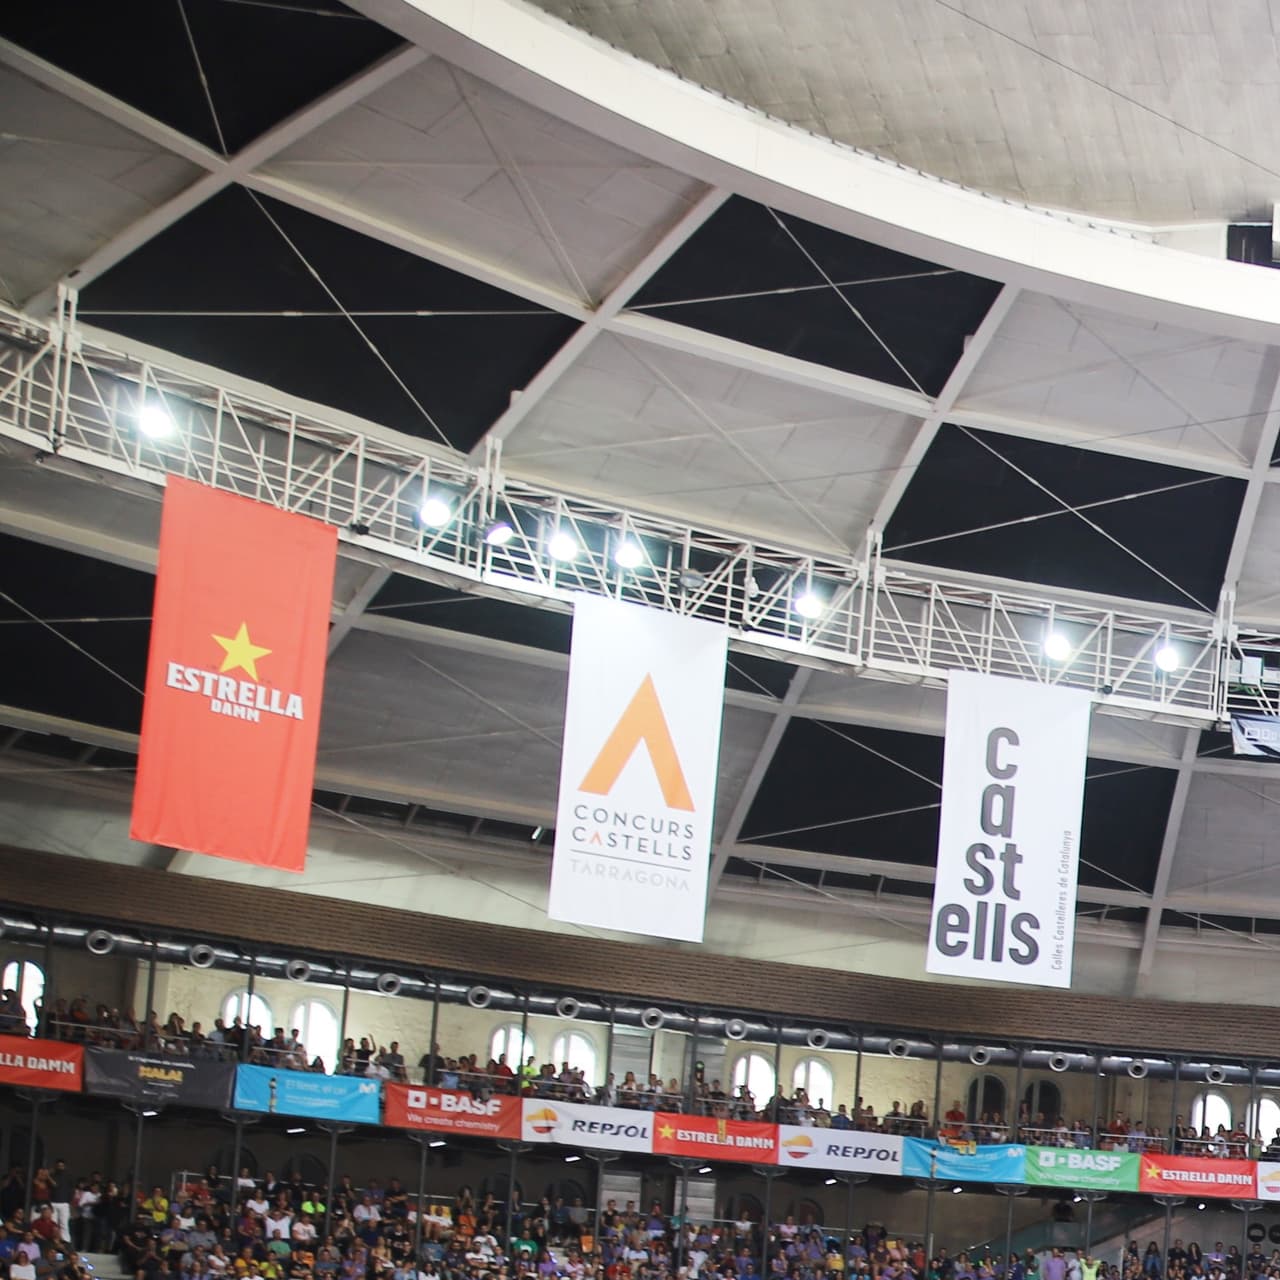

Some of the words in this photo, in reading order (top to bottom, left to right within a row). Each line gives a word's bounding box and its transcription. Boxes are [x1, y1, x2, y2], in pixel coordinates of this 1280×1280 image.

[166, 662, 304, 721] ESTRELLA
[211, 699, 260, 723] DAMM
[574, 804, 695, 839] CONCURS
[572, 827, 693, 861] CASTELLS
[571, 859, 691, 892] TARRAGONA
[27, 1057, 75, 1074] DAMM
[440, 1094, 502, 1116] BASF
[571, 1119, 649, 1139] REPSOL
[736, 1136, 774, 1148] DAMM
[826, 1144, 899, 1162] REPSOL
[1068, 1153, 1121, 1171] BASF
[1162, 1170, 1215, 1184] ESTRELLA
[1217, 1174, 1253, 1186] DAMM
